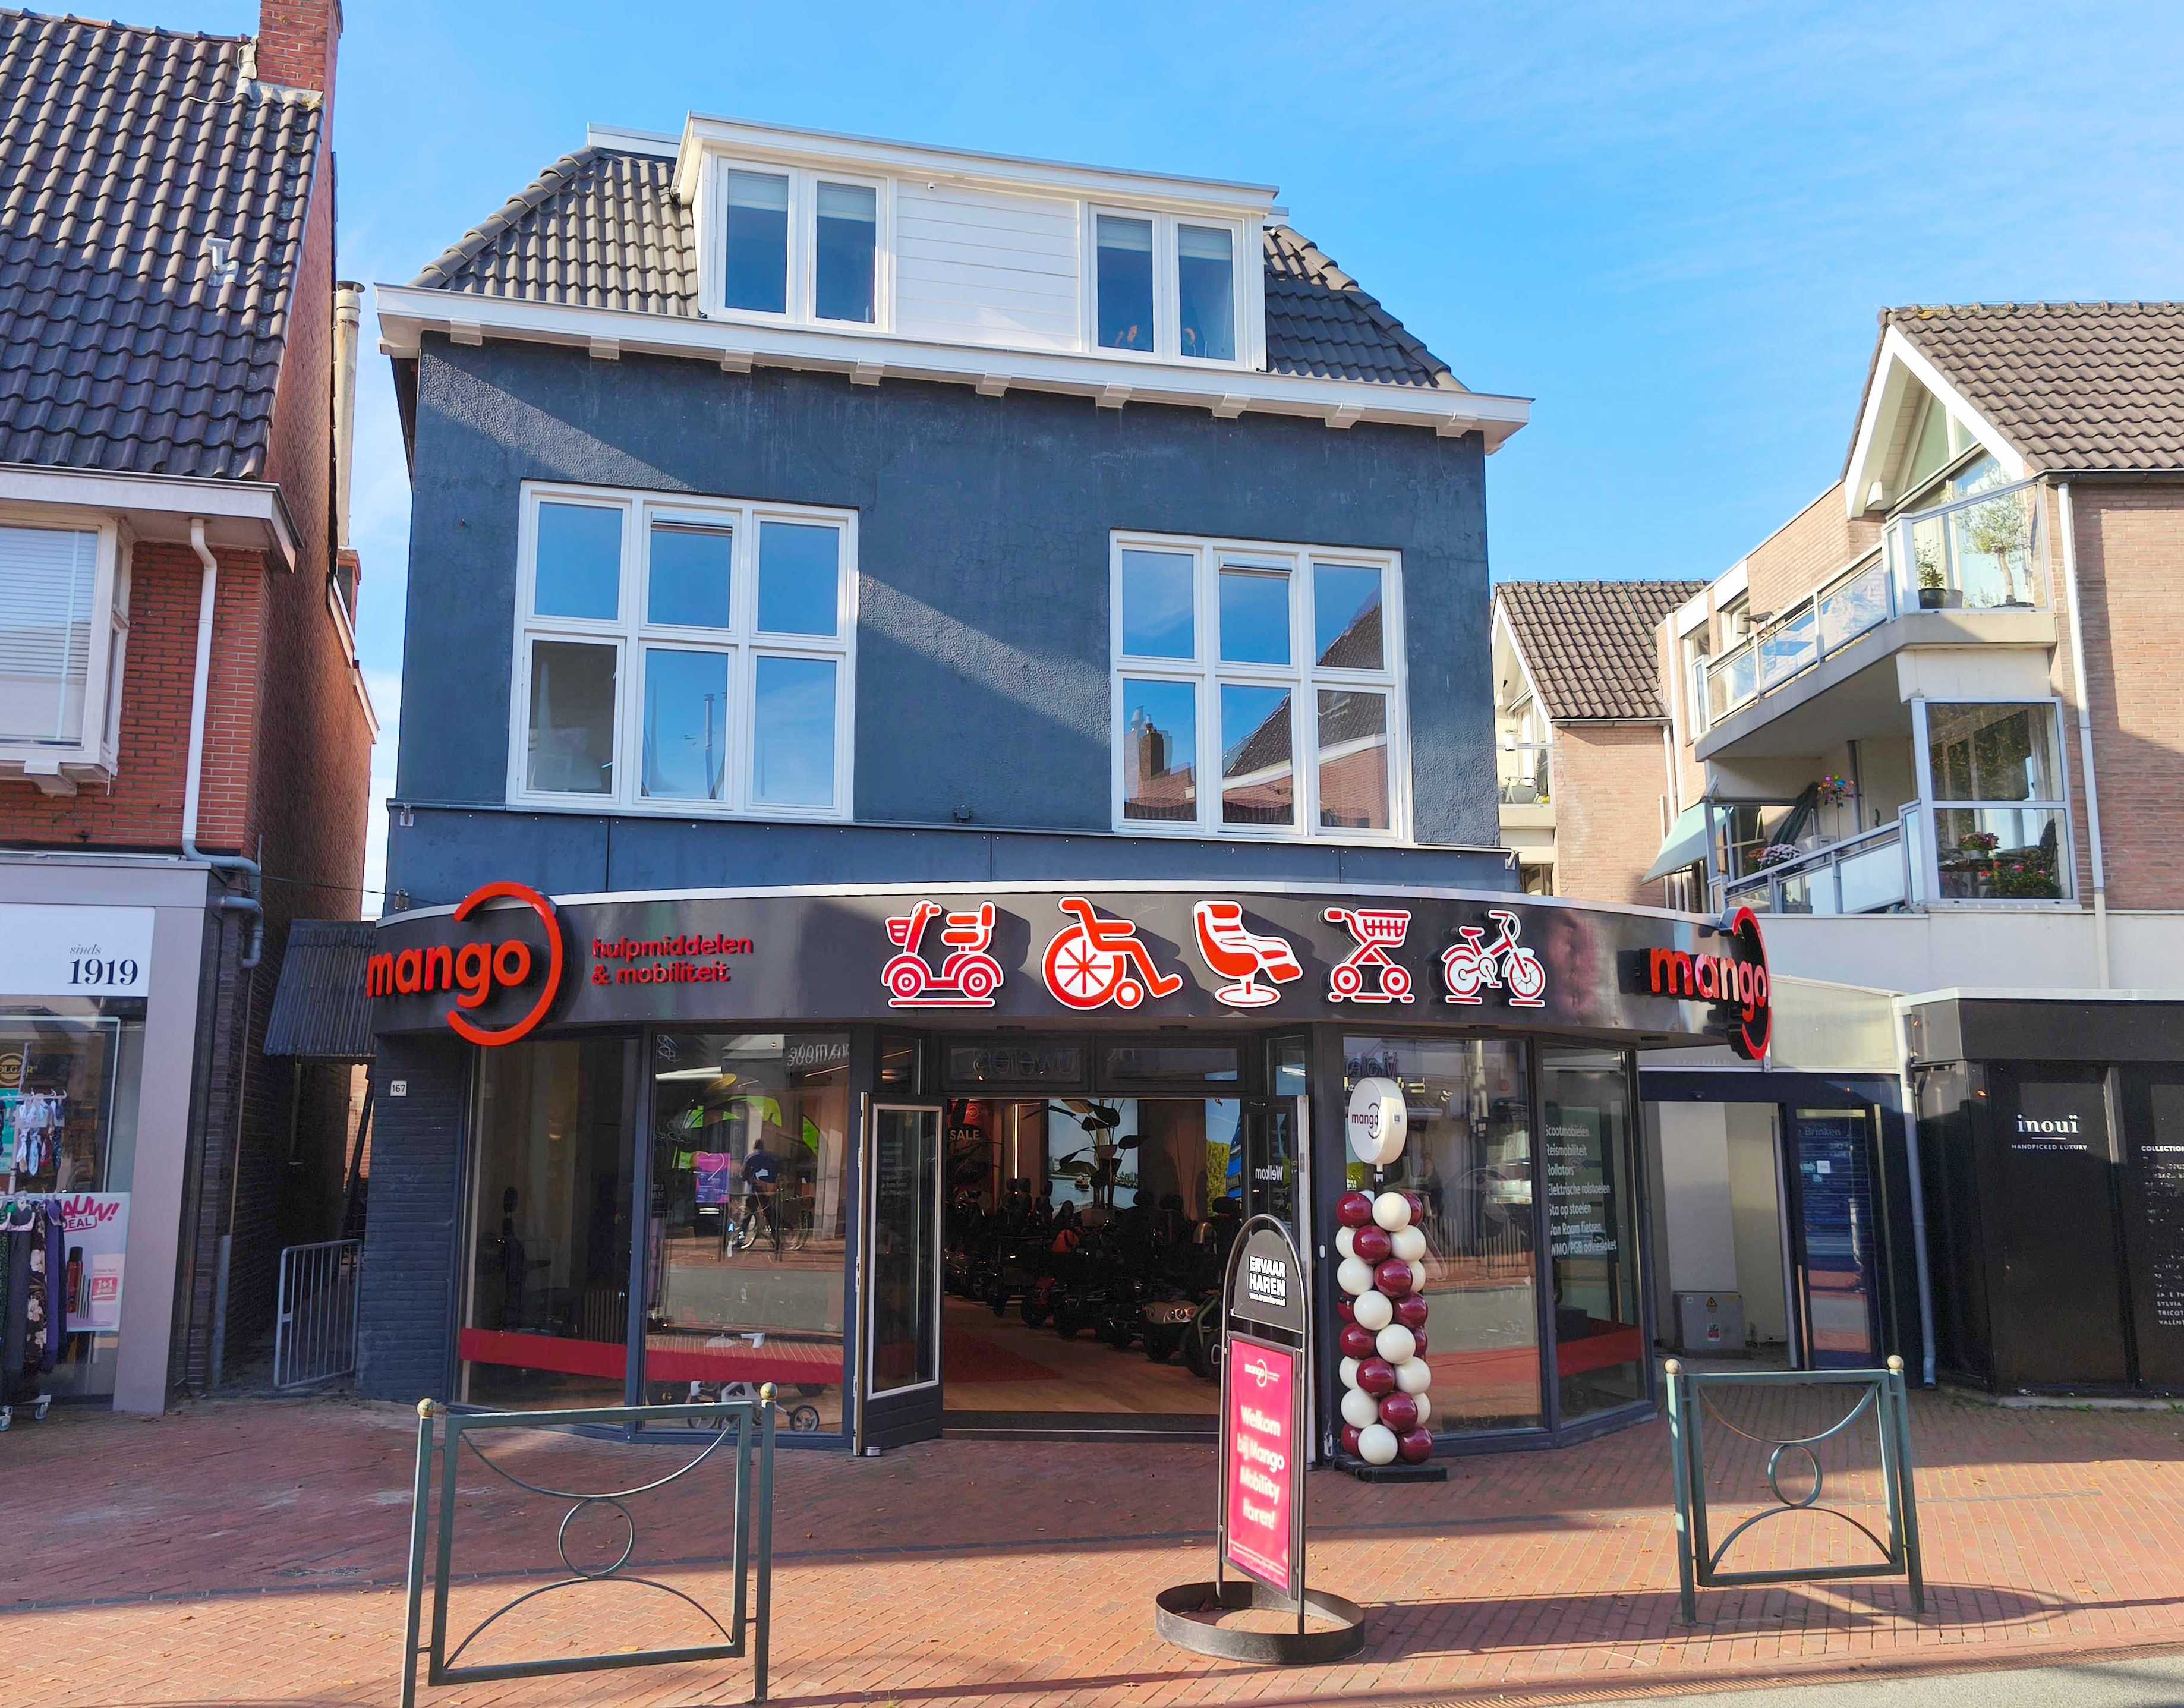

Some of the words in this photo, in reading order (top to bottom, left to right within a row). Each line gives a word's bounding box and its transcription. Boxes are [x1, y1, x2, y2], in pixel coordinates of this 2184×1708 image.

[70, 944, 102, 955] sinds
[592, 933, 754, 963] hulpmiddelen
[67, 959, 138, 985] 1919
[367, 939, 531, 1009] mango
[591, 963, 612, 985] &
[616, 959, 731, 985] mobiliteit
[1650, 947, 1767, 1022] mango
[392, 1084, 405, 1092] 167
[950, 1130, 980, 1140] SALE
[2016, 1114, 2079, 1133] inouï
[62, 1195, 120, 1222] AUW!
[1560, 1205, 1569, 1219] op
[1570, 1202, 1591, 1215] stoelen
[1249, 1256, 1286, 1278] ERVAAR
[1249, 1272, 1286, 1297] HAREN
[1240, 1404, 1281, 1437] Welkom
[1249, 1439, 1285, 1473] Mango
[1240, 1465, 1280, 1505] Mobility
[1243, 1497, 1276, 1530] Haren!
